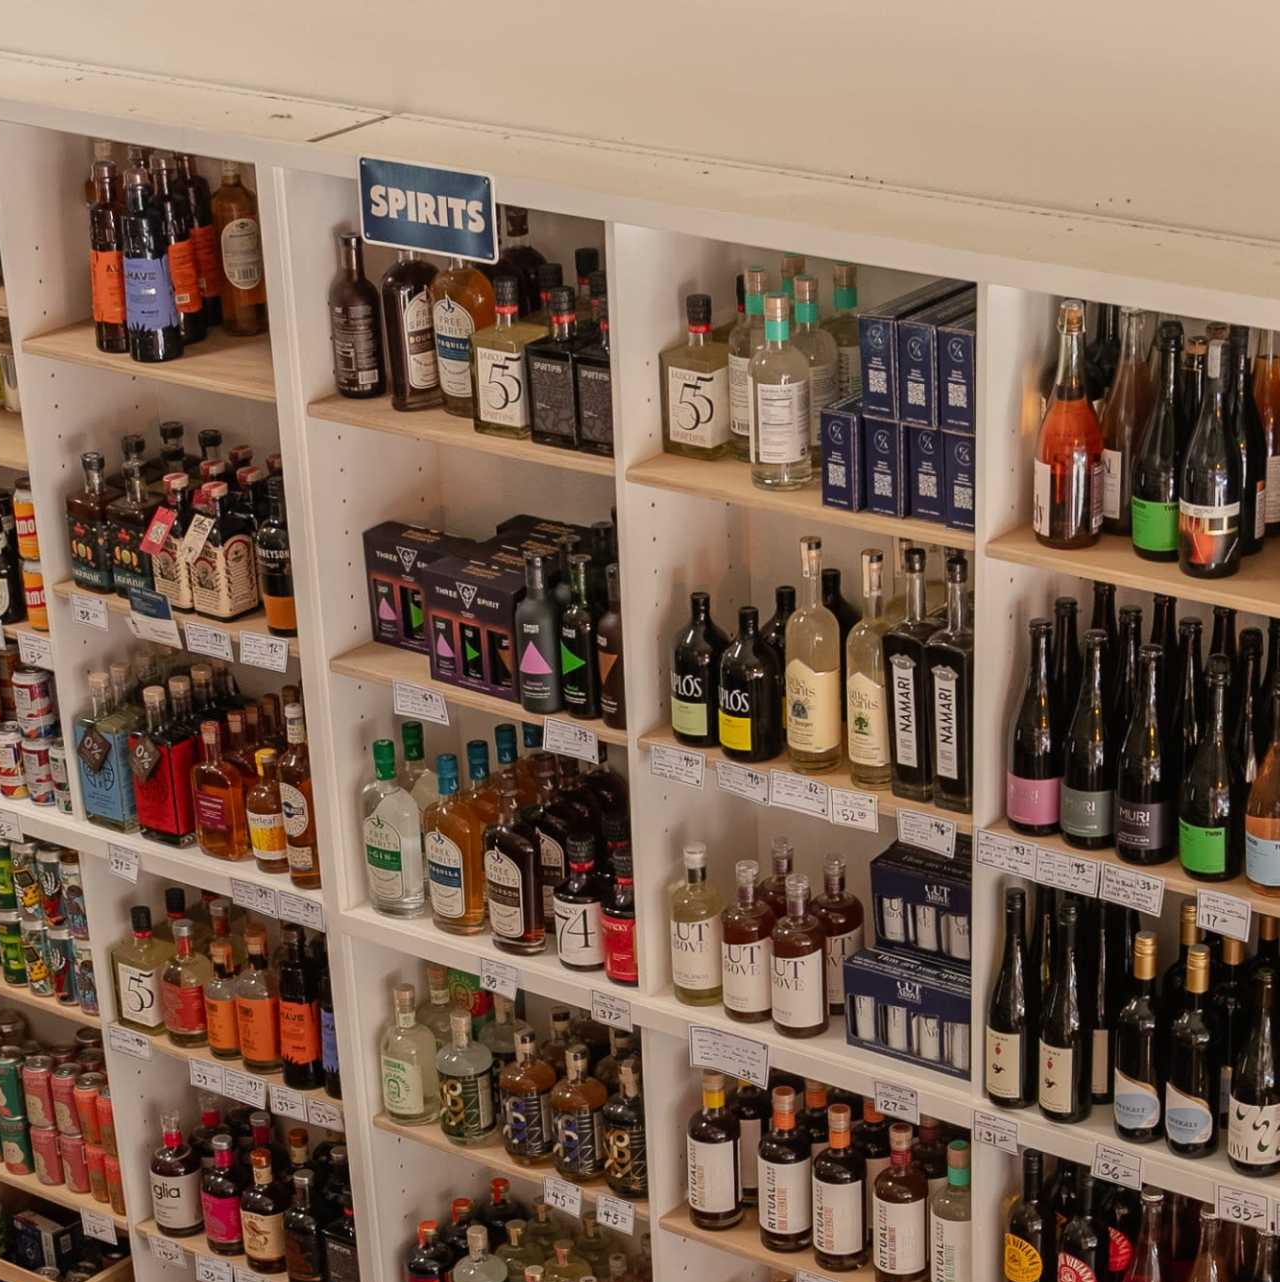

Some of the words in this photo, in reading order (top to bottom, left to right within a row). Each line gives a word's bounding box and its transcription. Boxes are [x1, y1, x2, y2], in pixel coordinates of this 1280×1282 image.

[370, 185, 485, 234] SPIRITS
[486, 356, 521, 409] 55
[679, 376, 714, 431] 55
[435, 586, 458, 599] THREE
[477, 598, 500, 610] SPIRIT
[898, 675, 913, 734] NAMARI
[938, 687, 953, 745] NAMARI
[1120, 808, 1151, 822] MURI
[673, 922, 709, 942] UT
[723, 945, 760, 965] UT
[772, 960, 805, 979] UT
[127, 973, 155, 1013] 55
